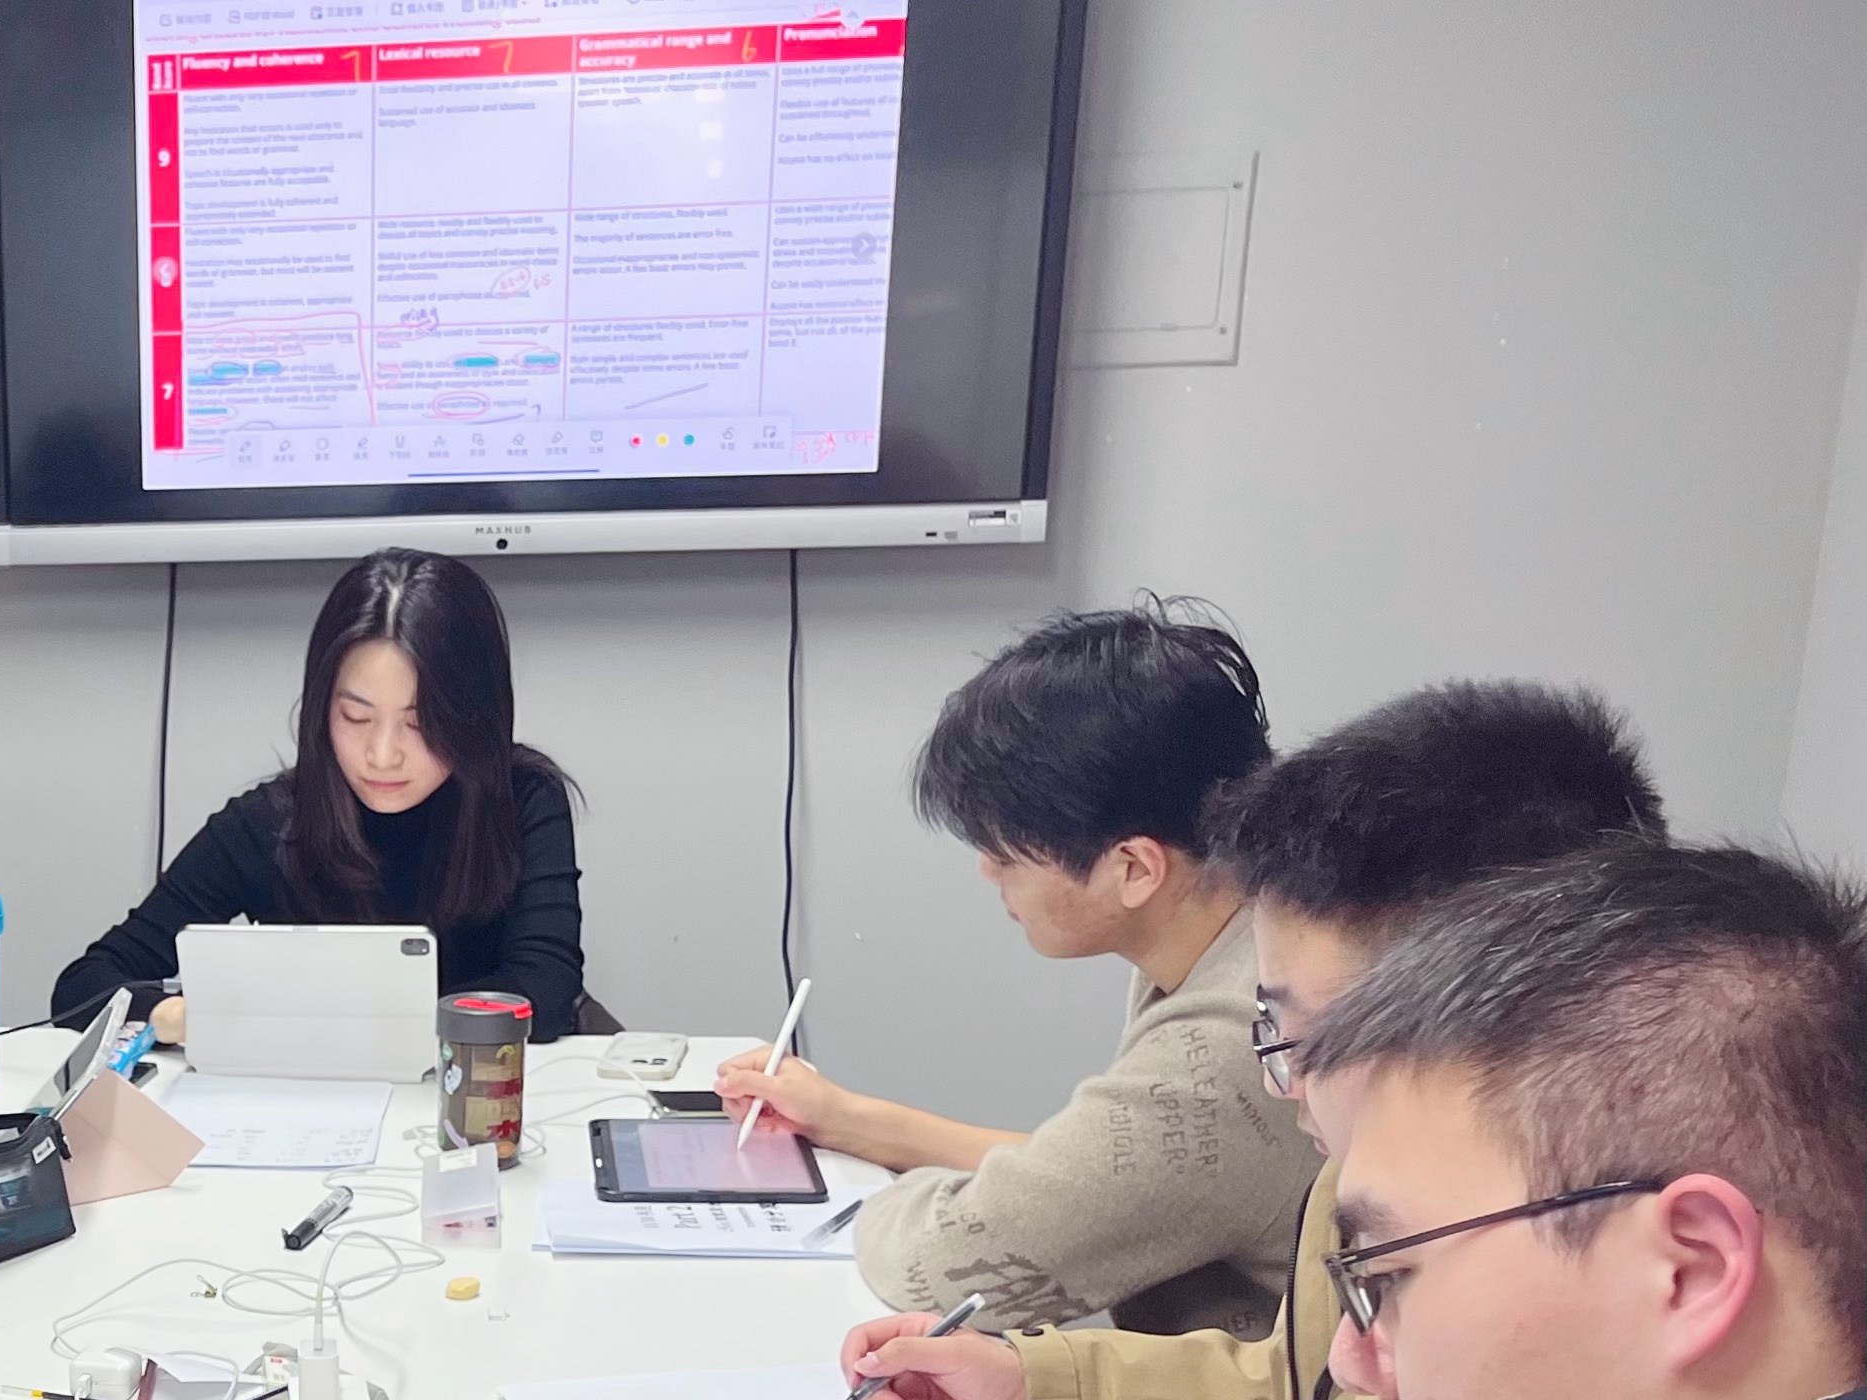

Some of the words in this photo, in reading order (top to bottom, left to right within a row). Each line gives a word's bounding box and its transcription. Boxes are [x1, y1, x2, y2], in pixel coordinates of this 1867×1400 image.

[579, 36, 664, 52] Grammatical
[666, 34, 705, 49] range
[707, 32, 732, 46] and
[182, 56, 231, 72] Fluency
[232, 54, 258, 69] and
[258, 53, 325, 67] coherence
[378, 47, 424, 63] Lexical
[425, 45, 482, 60] resource
[579, 53, 637, 68] accuracy
[157, 149, 171, 168] 9
[161, 382, 175, 401] 7
[475, 525, 532, 535] MAXHUB
